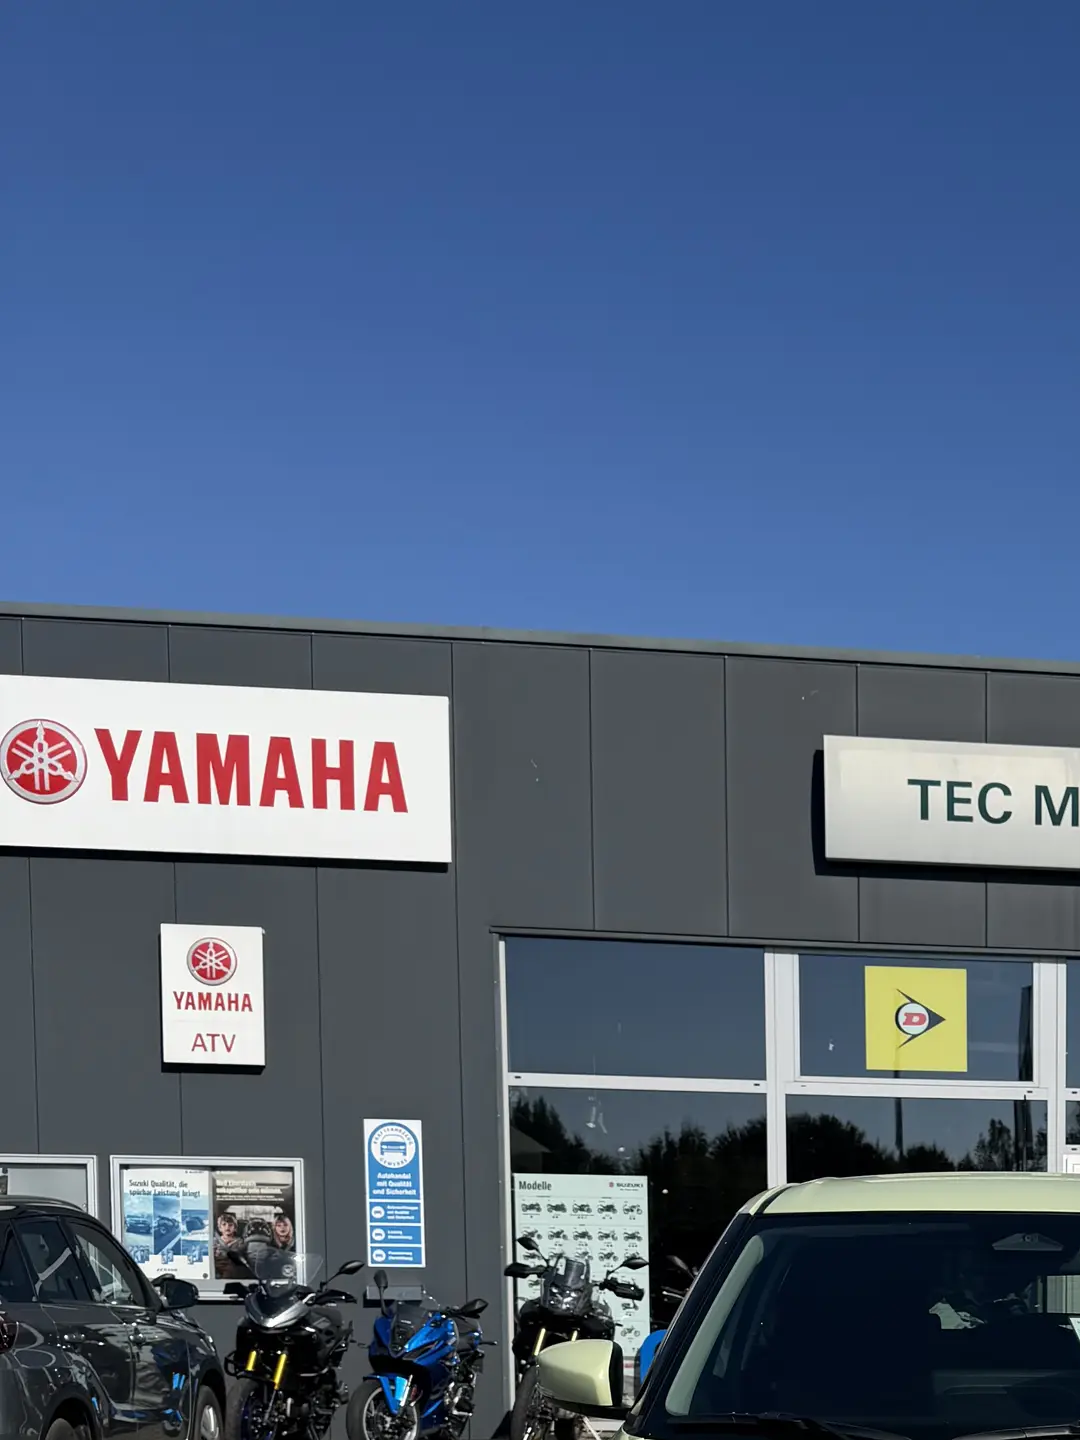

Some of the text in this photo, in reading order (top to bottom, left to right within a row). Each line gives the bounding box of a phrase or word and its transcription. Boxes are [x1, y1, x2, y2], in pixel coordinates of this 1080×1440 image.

[94, 727, 409, 814] YAMAHA
[907, 778, 1013, 824] TEC
[173, 990, 253, 1013] YAMAHA
[190, 1032, 236, 1054] ATV
[128, 1179, 149, 1187] Suzuki
[178, 1180, 189, 1188] die
[153, 1189, 181, 1198] Leistung
[182, 1190, 201, 1198] bringt
[519, 1180, 552, 1191] Modelle
